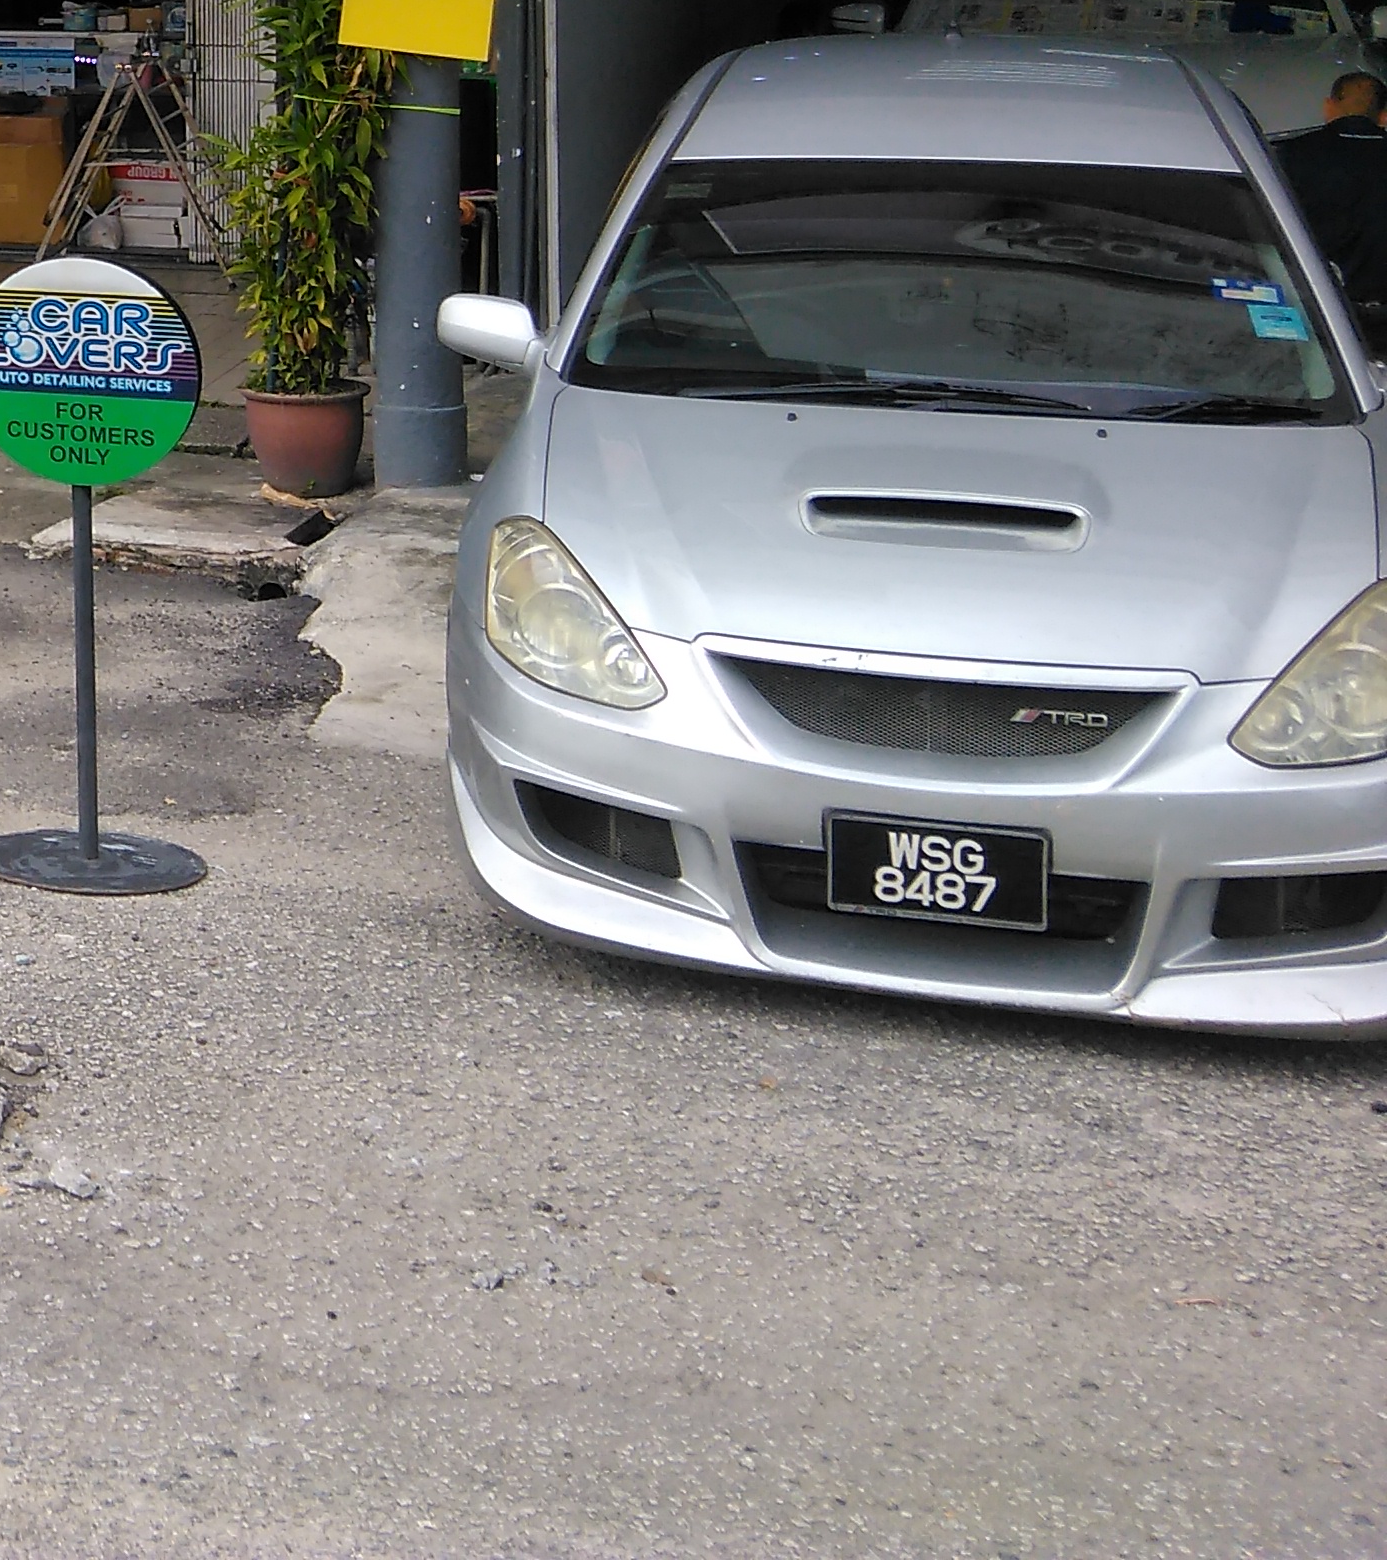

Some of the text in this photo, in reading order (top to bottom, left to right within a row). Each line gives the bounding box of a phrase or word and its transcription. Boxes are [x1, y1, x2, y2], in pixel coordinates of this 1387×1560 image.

[126, 164, 167, 180] GROUP
[29, 295, 153, 339] CAR
[32, 374, 107, 389] DETAILING
[109, 377, 172, 393] SERVICES
[55, 401, 104, 422] FOR
[6, 420, 156, 447] CUSTOMERS
[49, 445, 111, 466] ONLY
[1041, 709, 1109, 729] TRD
[887, 830, 985, 876] WSG
[873, 865, 997, 913] 8487
